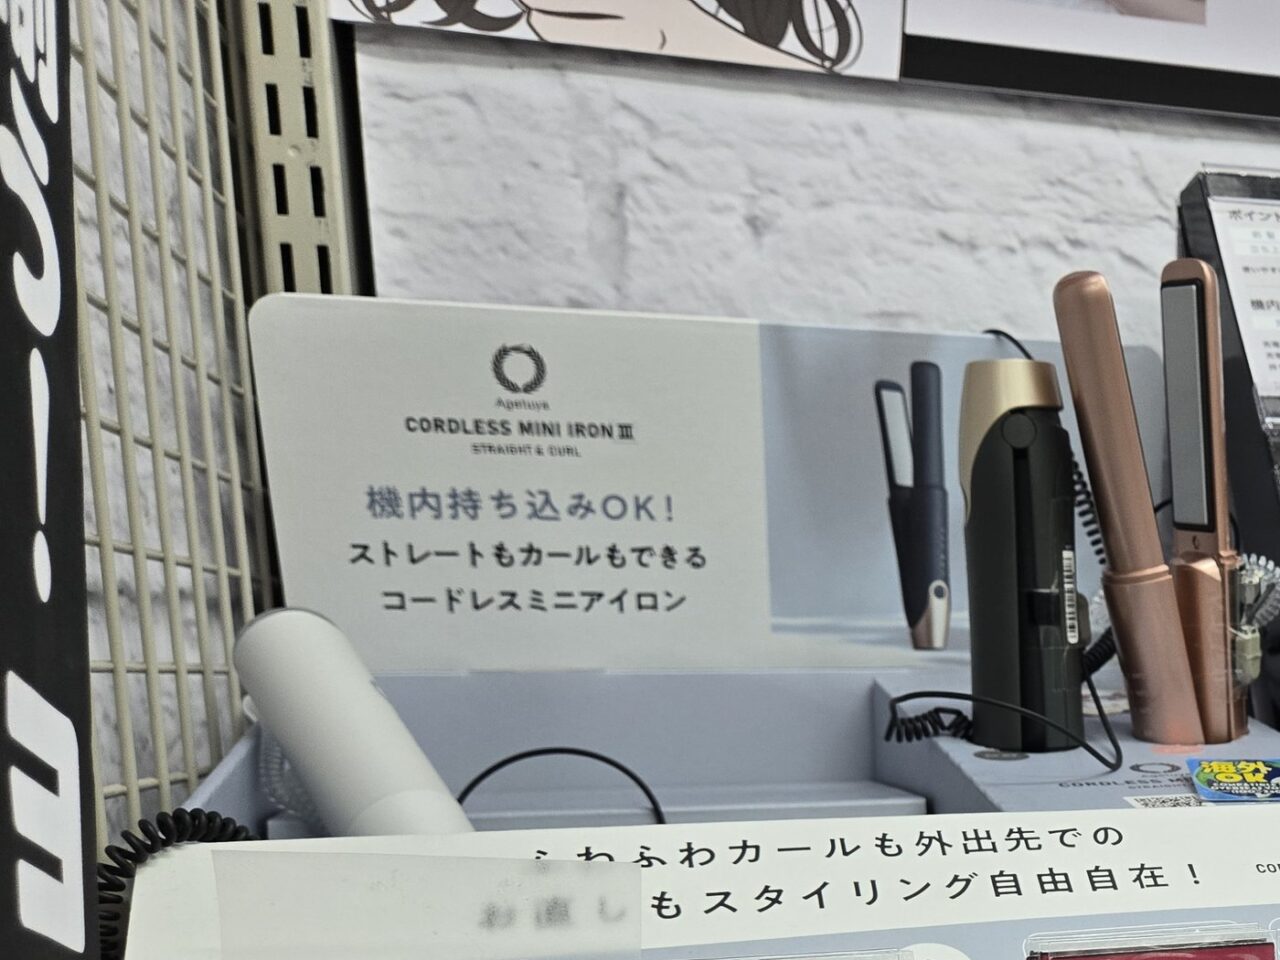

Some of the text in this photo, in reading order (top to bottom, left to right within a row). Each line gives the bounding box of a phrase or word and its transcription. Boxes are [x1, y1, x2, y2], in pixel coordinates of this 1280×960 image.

[405, 417, 614, 440] CORDLESS MINI IRON
[349, 540, 707, 570] ストレートもカールもできる
[381, 587, 687, 614] コードレスミニアイロン
